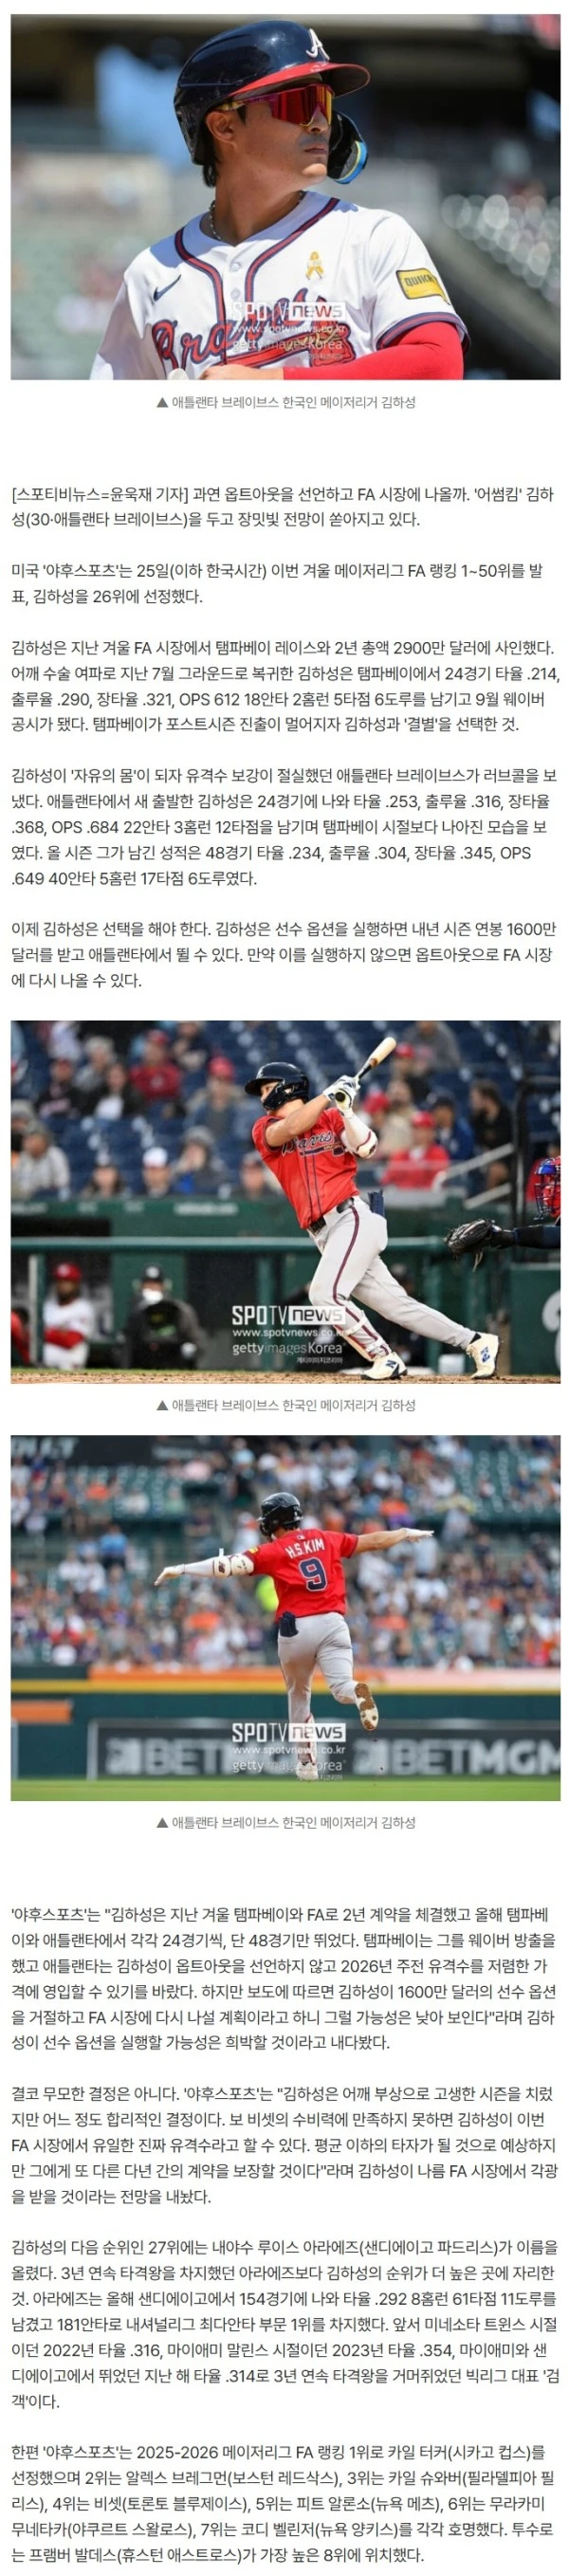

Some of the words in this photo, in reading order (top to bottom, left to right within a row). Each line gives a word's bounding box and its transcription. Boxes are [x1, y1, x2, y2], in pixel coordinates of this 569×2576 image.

[173, 396, 218, 409] 애틀랜타
[222, 396, 279, 408] 브레이브스
[283, 396, 316, 409] 한국인
[321, 396, 376, 409] 메이저리거
[382, 396, 414, 409] 김하성
[13, 488, 151, 504] [스포티비뉴스=윤욱재
[156, 488, 188, 504] 기자]
[193, 487, 219, 502] 과연
[225, 488, 293, 502] 옵트아웃을
[299, 487, 353, 502] 선언하고
[358, 488, 376, 501] FA
[379, 488, 420, 502] 시장에
[426, 488, 469, 502] 나올까.
[475, 487, 522, 502] '어썸킴'
[526, 488, 554, 502] 김하
[12, 512, 110, 528] 성(30·애틀랜타
[114, 512, 202, 528] 브레이브스)을
[207, 512, 233, 526] 두고
[238, 512, 279, 526] 장밋빛
[284, 512, 323, 526] 전망이
[330, 512, 384, 526] 쏟아지고
[389, 512, 419, 526] 있다.
[12, 640, 66, 655] 김하성은
[72, 641, 99, 655] 지난
[103, 640, 130, 655] 겨울
[135, 642, 152, 653] FA
[156, 640, 211, 655] 시장에서
[216, 640, 269, 655] 탬파베이
[276, 640, 331, 655] 레이스와
[335, 641, 357, 654] 2년
[362, 640, 389, 655] 총액
[394, 640, 445, 654] 2900만
[450, 640, 490, 655] 달러에
[495, 640, 554, 655] 사인했다.
[11, 717, 53, 732] 공시가
[58, 717, 88, 731] 됐다.
[94, 717, 162, 732] 탬파베이가
[166, 717, 235, 731] 포스트시즌
[240, 717, 280, 731] 진출이
[285, 717, 340, 732] 멀어지자
[345, 717, 400, 732] 김하성과
[405, 717, 451, 731] '결별'을
[456, 717, 498, 731] 선택한
[503, 717, 519, 731] 것.
[12, 821, 46, 837] .368,
[52, 821, 83, 834] OPS
[87, 821, 119, 833] .684
[124, 819, 170, 835] 22안타
[174, 819, 211, 835] 3홈런
[215, 819, 273, 835] 12타점을
[278, 819, 318, 835] 남기며
[323, 819, 376, 835] 탬파베이
[382, 819, 438, 835] 시절보다
[443, 819, 483, 835] 나아진
[487, 820, 528, 835] 모습을
[533, 821, 546, 833] 보
[11, 973, 25, 988] 에
[29, 973, 55, 988] 다시
[62, 973, 88, 988] 나올
[93, 974, 106, 988] 수
[111, 973, 141, 988] 있다.
[173, 1400, 218, 1411] 애틀랜타
[223, 1400, 278, 1411] 브레이브스
[284, 1400, 316, 1411] 한국인
[321, 1400, 376, 1411] 메이저리거
[382, 1400, 414, 1411] 김하성
[299, 1556, 327, 1592] 9
[173, 1817, 218, 1829] 애틀랜타
[223, 1817, 278, 1829] 브레이브스
[284, 1817, 316, 1829] 한국인
[321, 1817, 376, 1829] 메이저리거
[382, 1817, 414, 1829] 김하성
[12, 1907, 101, 1923] '야후스포츠'는
[105, 1907, 166, 1923] "김하성은
[171, 1907, 198, 1923] 지난
[203, 1907, 229, 1923] 겨울
[234, 1907, 303, 1923] 탬파베이와
[308, 1908, 339, 1921] FA로
[343, 1907, 364, 1922] 2년
[371, 1907, 411, 1922] 계약을
[415, 1907, 470, 1923] 체결했고
[475, 1907, 502, 1922] 올해
[507, 1907, 547, 1923] 탬파베
[12, 2035, 38, 2050] 성이
[44, 2035, 70, 2050] 선수
[75, 2035, 116, 2050] 옵션을
[121, 2035, 162, 2050] 실행할
[167, 2035, 221, 2050] 가능성은
[226, 2035, 267, 2050] 희박할
[272, 2035, 326, 2050] 것이라고
[331, 2035, 390, 2050] 내다봤다.
[12, 2112, 39, 2127] 지만
[44, 2112, 70, 2127] 어느
[75, 2112, 102, 2127] 정도
[107, 2112, 161, 2127] 합리적인
[167, 2112, 225, 2127] 결정이다.
[229, 2113, 243, 2125] 보
[248, 2112, 287, 2127] 비셋의
[293, 2112, 347, 2127] 수비력에
[353, 2112, 407, 2127] 만족하지
[413, 2112, 452, 2127] 못하면
[458, 2112, 511, 2127] 김하성이
[518, 2112, 543, 2127] 이번
[12, 2291, 28, 2306] 것.
[33, 2291, 102, 2307] 아라에즈는
[106, 2291, 133, 2307] 올해
[138, 2291, 234, 2307] 샌디에이고에서
[240, 2291, 306, 2307] 154경기에
[312, 2291, 340, 2307] 나와
[344, 2291, 371, 2307] 타율
[376, 2292, 407, 2305] .292
[412, 2291, 448, 2306] 8홈런
[453, 2291, 496, 2307] 61타점
[502, 2292, 556, 2307] 11도루를
[12, 2471, 80, 2486] 선정했으며
[85, 2471, 121, 2486] 2위는
[126, 2471, 168, 2485] 알렉스
[172, 2471, 273, 2488] 브레그먼(보스턴
[279, 2471, 342, 2488] 레드삭스),
[348, 2471, 384, 2485] 3위는
[389, 2471, 415, 2485] 카일
[420, 2471, 537, 2487] 슈와버(필라델피아
[541, 2471, 554, 2485] 필
[11, 2548, 25, 2562] 는
[29, 2548, 69, 2563] 프램버
[76, 2548, 162, 2565] 발데스(휴스턴
[168, 2548, 256, 2565] 애스트로스)가
[261, 2548, 287, 2563] 가장
[292, 2548, 320, 2563] 높은
[324, 2548, 360, 2563] 8위에
[365, 2548, 424, 2563] 위치했다.
